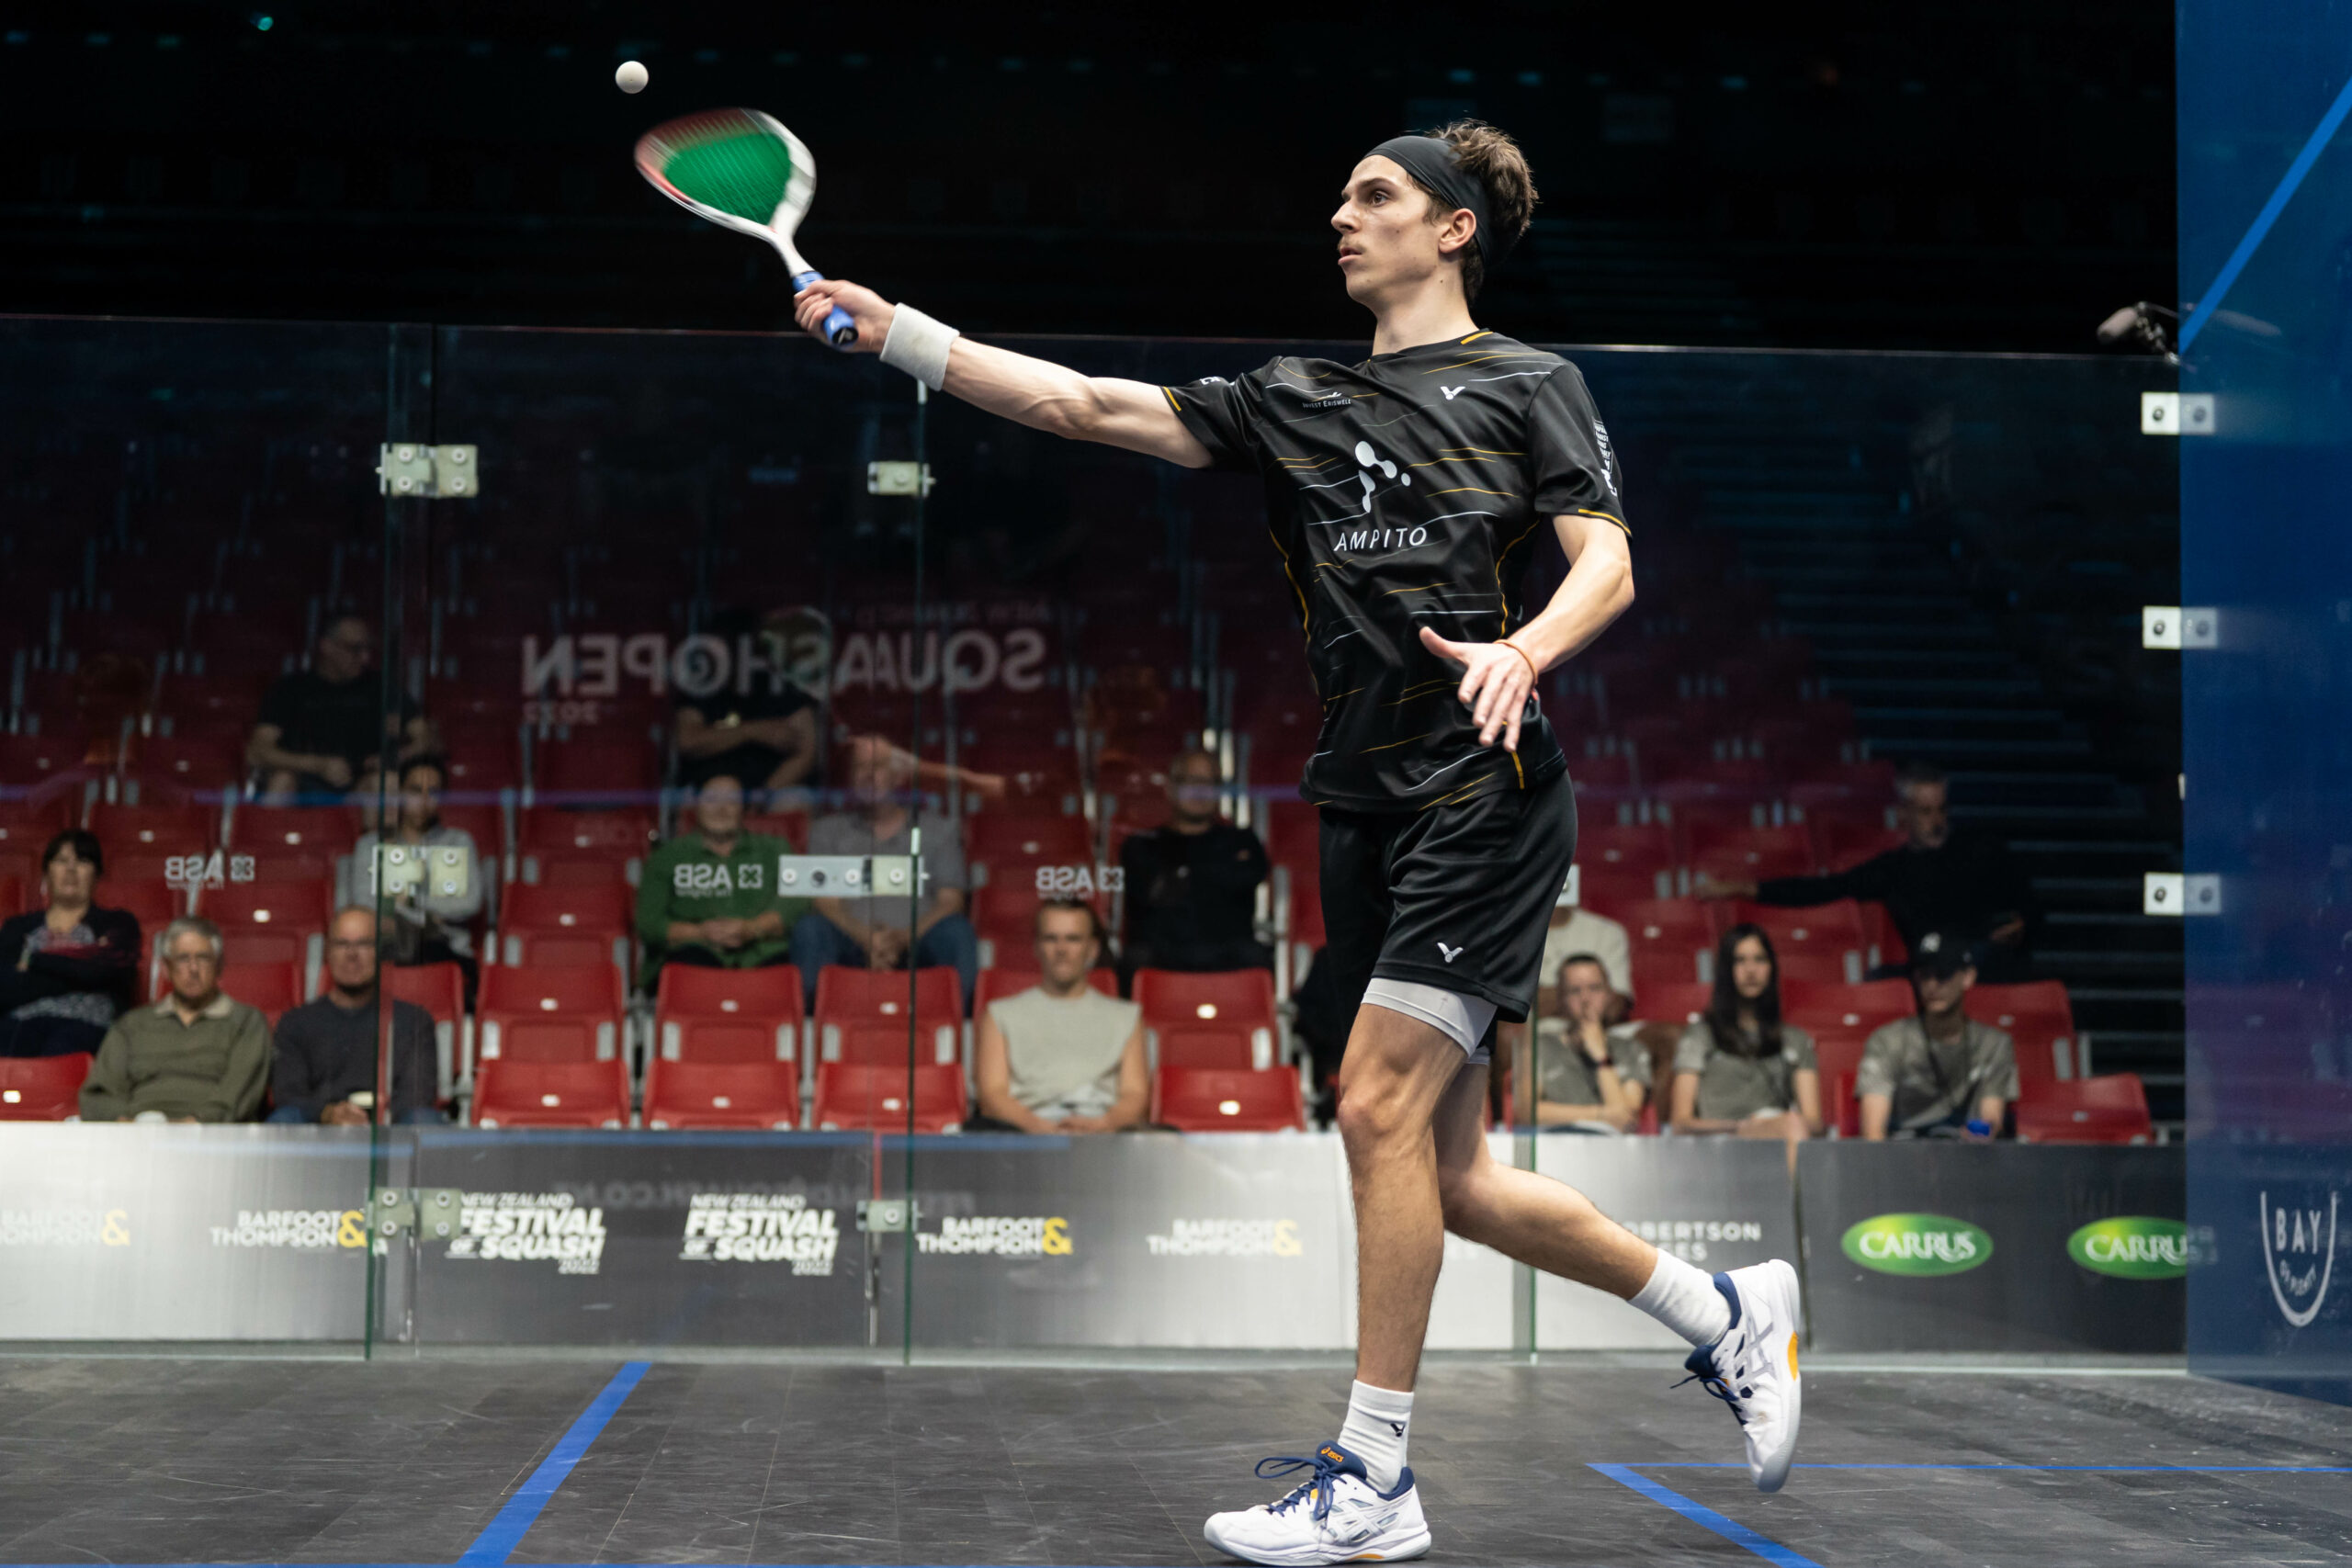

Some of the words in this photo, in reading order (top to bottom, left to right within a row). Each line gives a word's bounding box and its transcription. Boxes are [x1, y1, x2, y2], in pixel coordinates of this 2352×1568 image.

[1333, 526, 1428, 552] AMPITO
[497, 1193, 573, 1209] ZEALAND
[690, 1193, 729, 1209] NEW
[729, 1194, 807, 1210] ZEALAND
[237, 1210, 342, 1228] BARFOOT
[684, 1209, 839, 1237] FESTIVAL
[943, 1216, 1046, 1235] BARFOOT
[2276, 1207, 2322, 1255] BAY
[209, 1226, 338, 1247] THOMPSON
[1622, 1221, 1761, 1242] OBERTSON
[480, 1235, 605, 1261] SQUASH
[713, 1236, 838, 1262] SQUASH
[915, 1233, 1044, 1255] THOMPSON
[1859, 1231, 1976, 1263] CARRUS
[2085, 1234, 2188, 1266] CARRU
